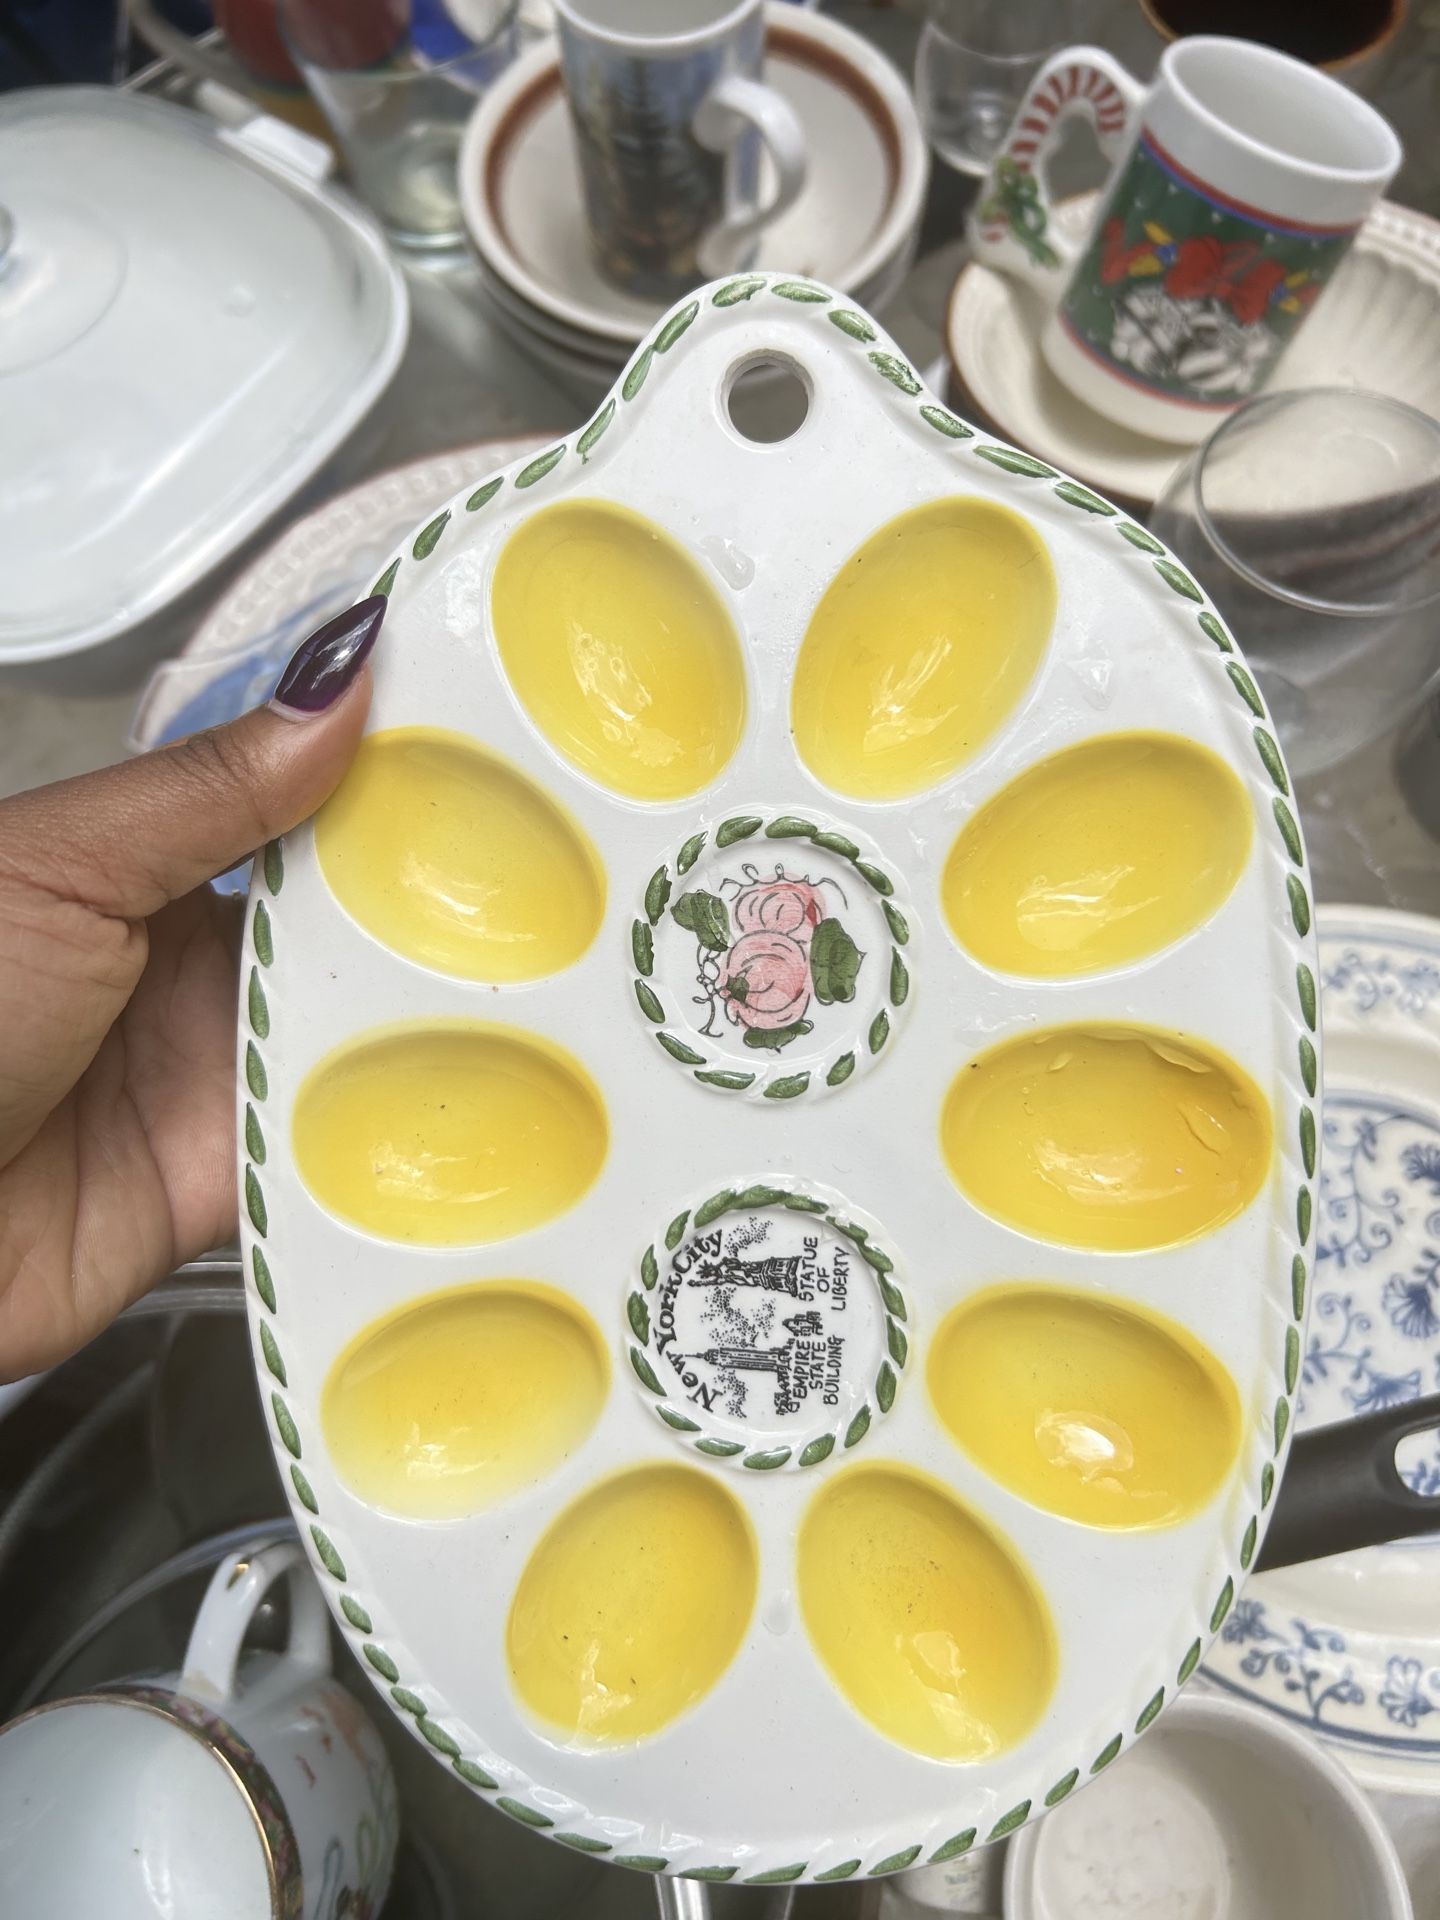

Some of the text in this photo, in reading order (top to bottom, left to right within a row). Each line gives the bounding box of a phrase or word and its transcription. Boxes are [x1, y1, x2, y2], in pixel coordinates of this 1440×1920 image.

[798, 1237, 818, 1301] STATUE
[817, 1267, 830, 1293] OF
[831, 1247, 850, 1311] LIBERTY
[653, 1229, 723, 1413] New York City
[793, 1340, 810, 1399] EMPIRE
[809, 1342, 826, 1390] STATE
[823, 1335, 845, 1405] BUILDING
